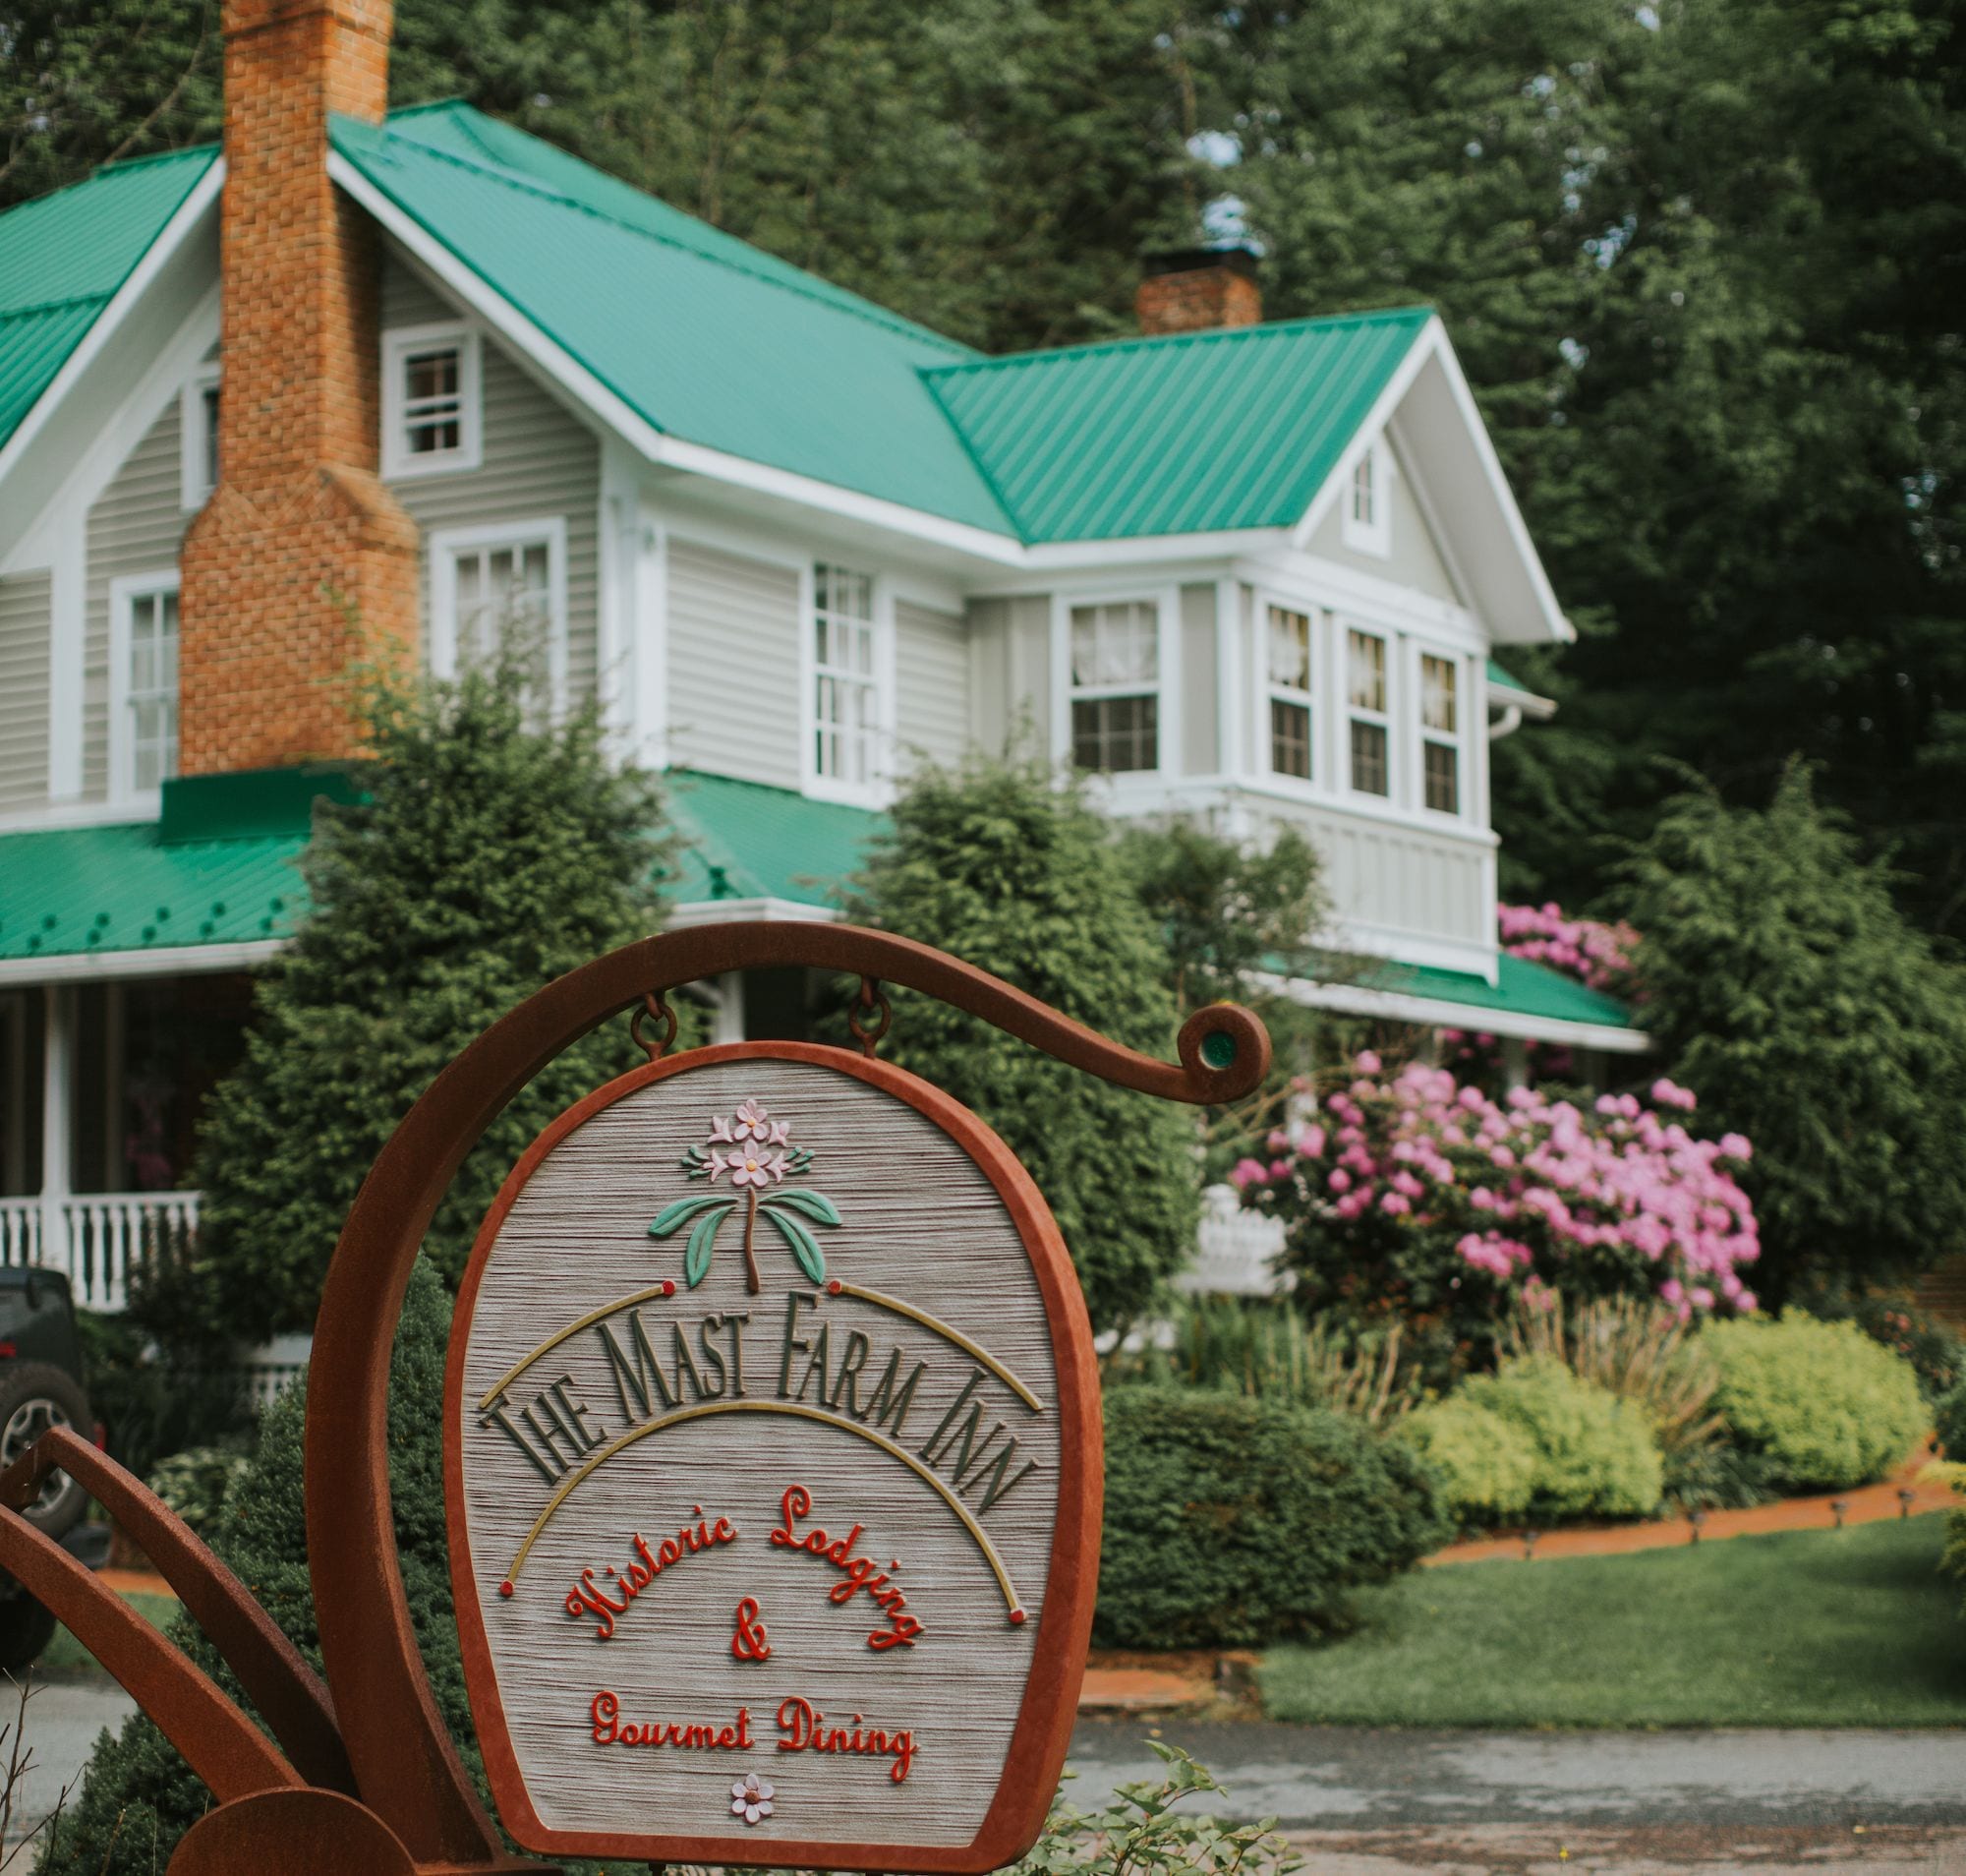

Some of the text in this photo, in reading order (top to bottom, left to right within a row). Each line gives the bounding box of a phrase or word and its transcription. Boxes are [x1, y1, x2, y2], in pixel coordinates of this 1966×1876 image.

[480, 1290, 1039, 1515] THE MAST FARM INN
[565, 1484, 926, 1650] Historic Lodging
[731, 1597, 773, 1662] &
[590, 1690, 920, 1784] Gourmet Dining
